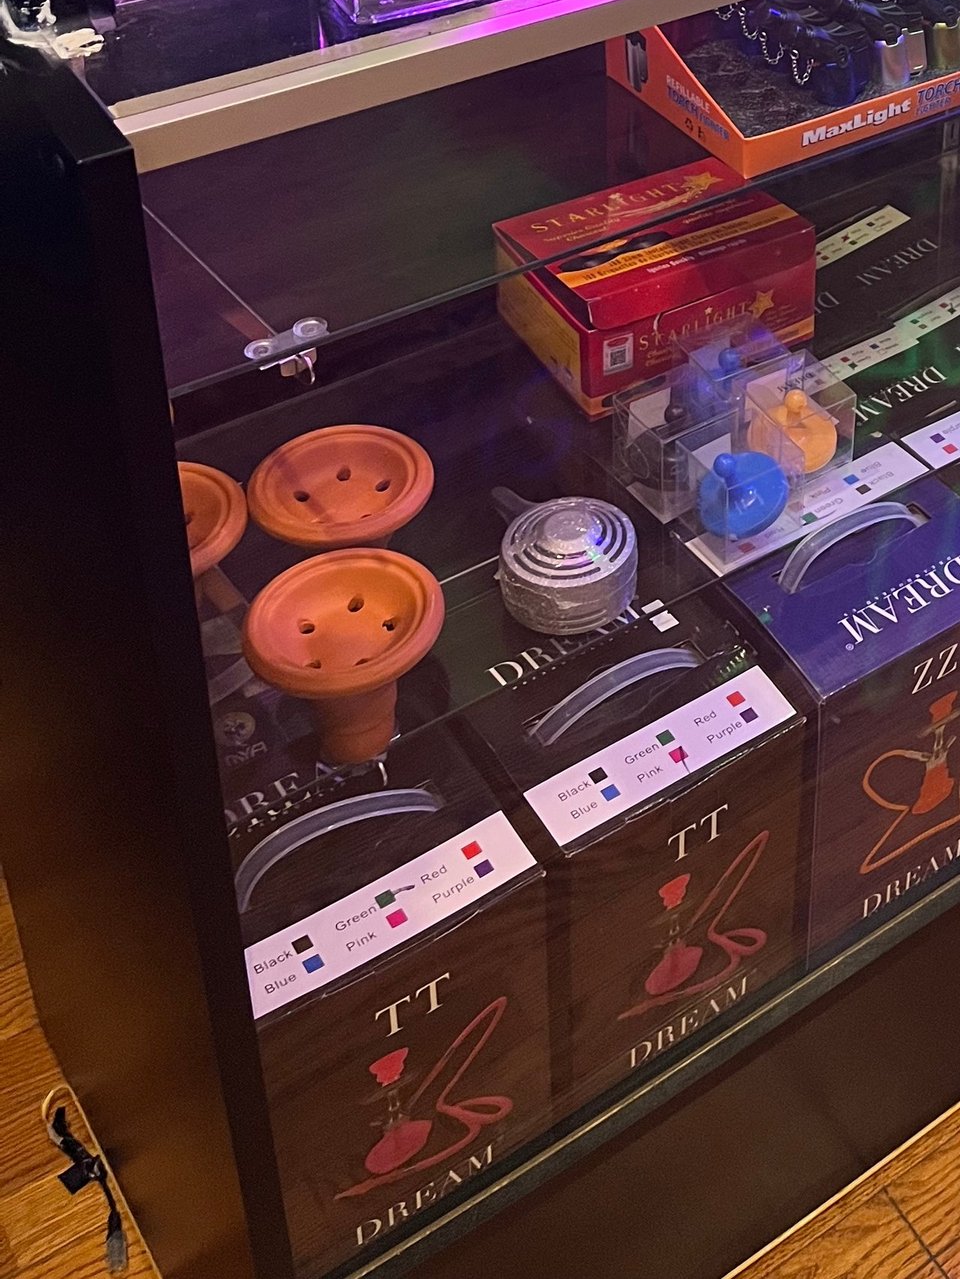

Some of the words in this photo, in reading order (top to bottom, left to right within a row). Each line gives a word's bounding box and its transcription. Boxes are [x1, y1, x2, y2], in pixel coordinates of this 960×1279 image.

[801, 97, 913, 148] MaxLight
[852, 365, 948, 424] DREAM
[860, 460, 882, 474] Blue
[868, 470, 895, 486] Black
[911, 643, 959, 695] ZZ
[693, 710, 718, 727] Red
[706, 719, 743, 745] Purple
[623, 742, 660, 766] Green
[636, 765, 664, 784] Pink
[556, 779, 593, 803] Black
[570, 800, 599, 820] Blue
[667, 803, 729, 862] TT
[419, 864, 448, 885] Red
[431, 874, 475, 904] Purple
[335, 905, 378, 932] Green
[345, 930, 378, 952] Pink
[253, 950, 293, 975] Black
[263, 972, 297, 995] Blue
[375, 972, 450, 1038] TT
[629, 976, 749, 1069] DREAM
[355, 1144, 494, 1246] DREAM
